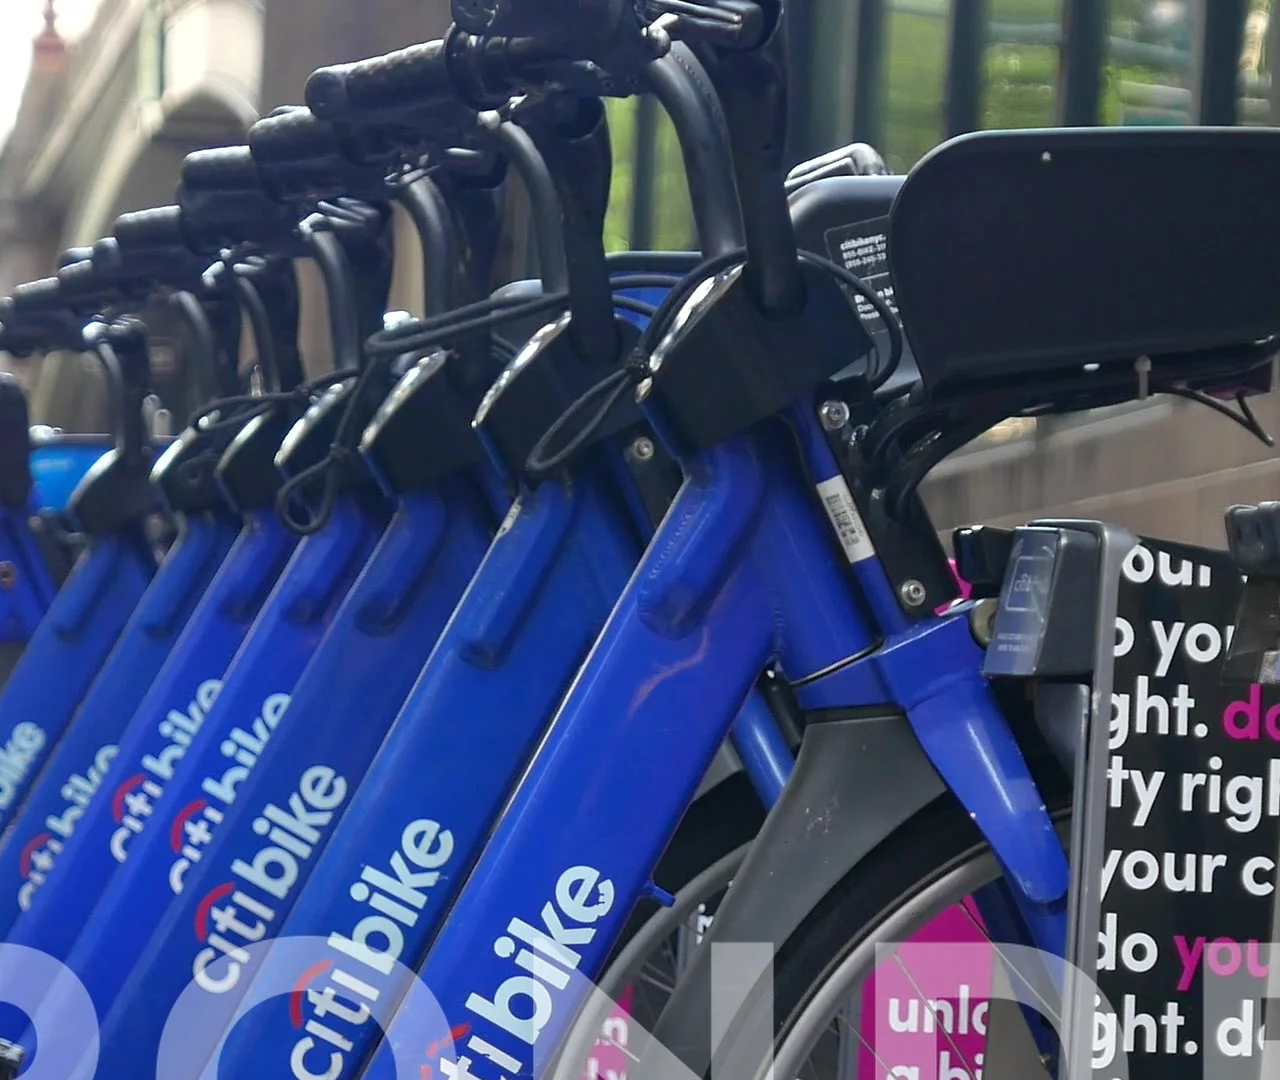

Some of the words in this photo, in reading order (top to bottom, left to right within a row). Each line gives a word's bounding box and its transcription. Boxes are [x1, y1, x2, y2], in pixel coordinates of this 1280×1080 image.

[231, 765, 348, 899] bike
[1107, 756, 1166, 827] ty
[327, 818, 455, 975] bike
[1100, 848, 1227, 900] your
[1242, 854, 1275, 896] c
[192, 889, 276, 993] citi
[465, 865, 615, 1045] bike
[1094, 912, 1159, 972] do
[1089, 993, 1199, 1069] ght.
[1216, 999, 1266, 1058] d
